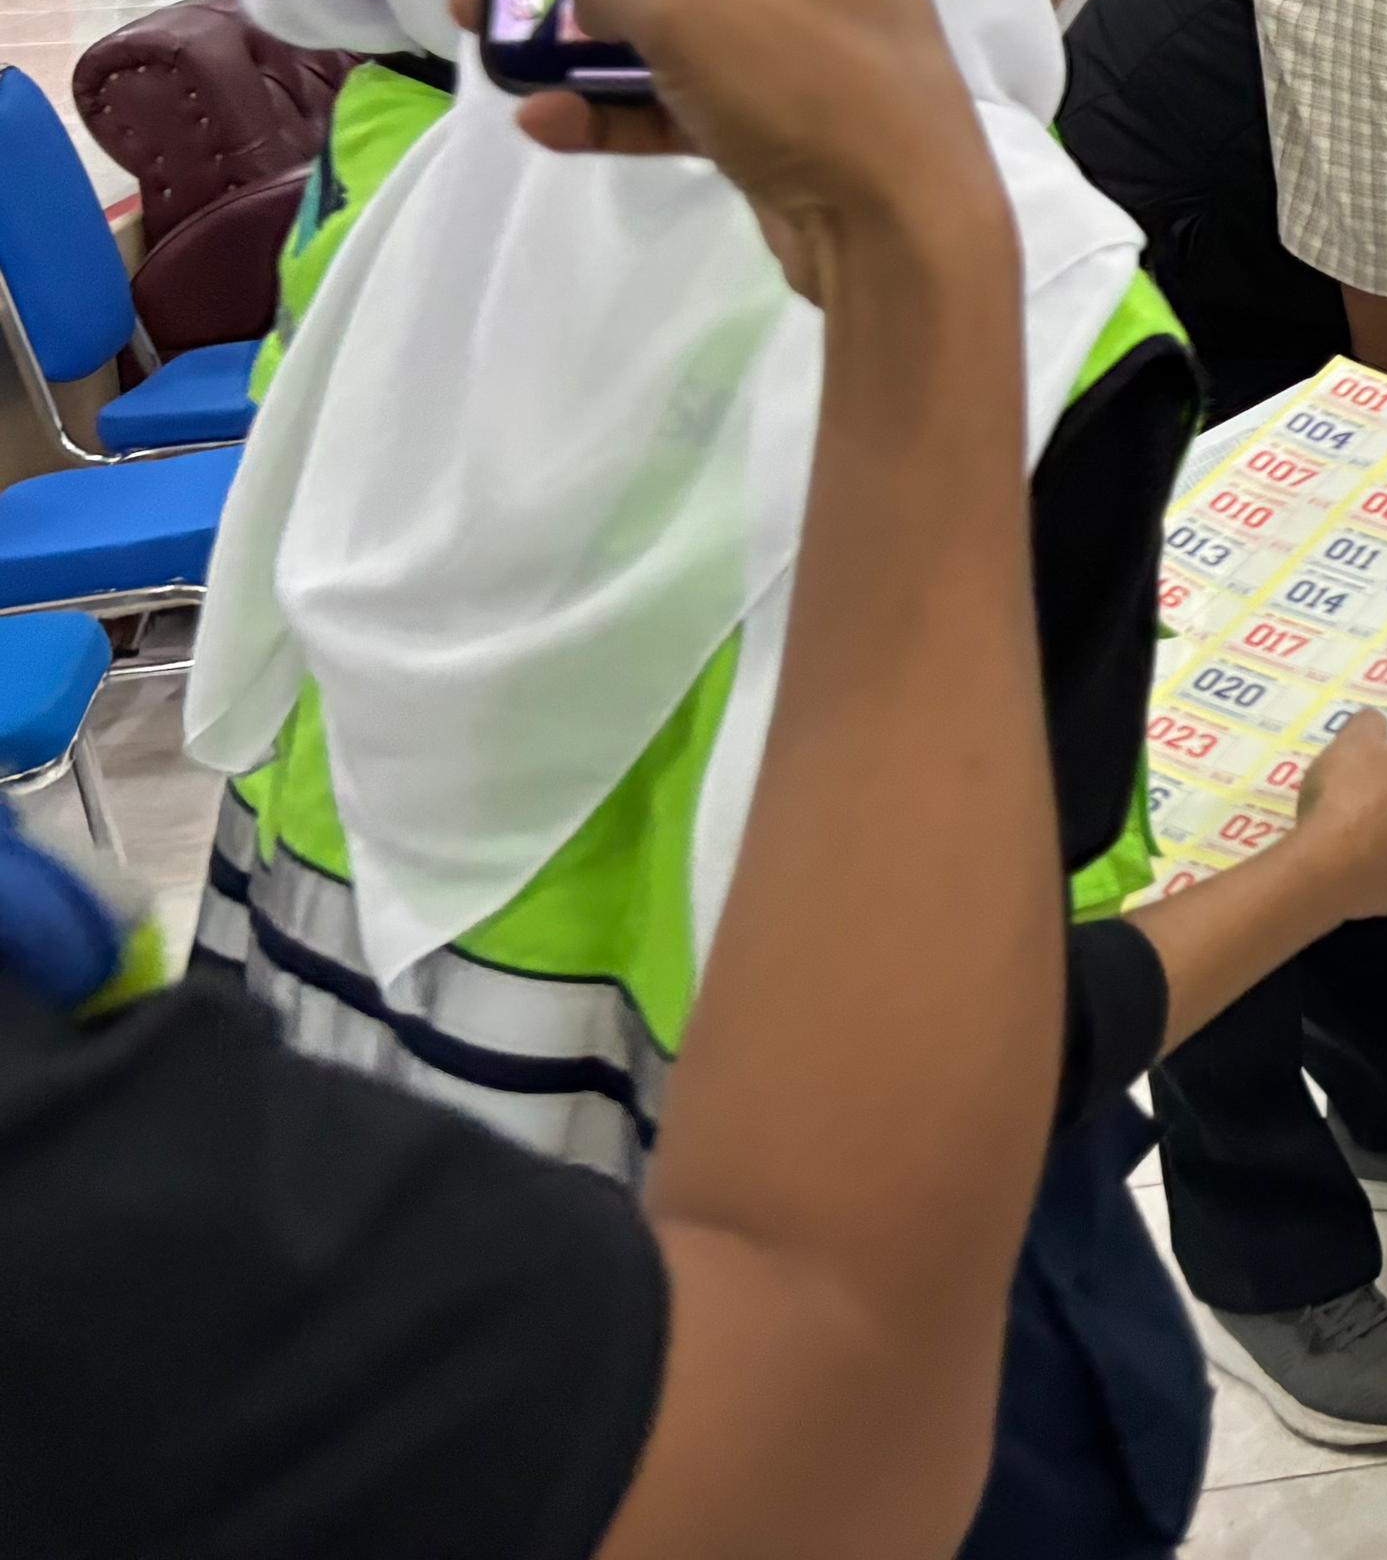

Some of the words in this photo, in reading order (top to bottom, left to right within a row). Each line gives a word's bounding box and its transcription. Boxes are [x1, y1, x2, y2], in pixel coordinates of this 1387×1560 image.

[1286, 412, 1355, 450] 004
[1248, 450, 1320, 487] 007
[1209, 491, 1276, 529] 010
[1167, 526, 1232, 567] 013
[1324, 537, 1382, 571] 011
[1286, 580, 1350, 614] 014
[1245, 623, 1310, 658] 017
[1192, 668, 1267, 707] 020
[1146, 716, 1219, 759] 023
[1219, 814, 1288, 849] 02
